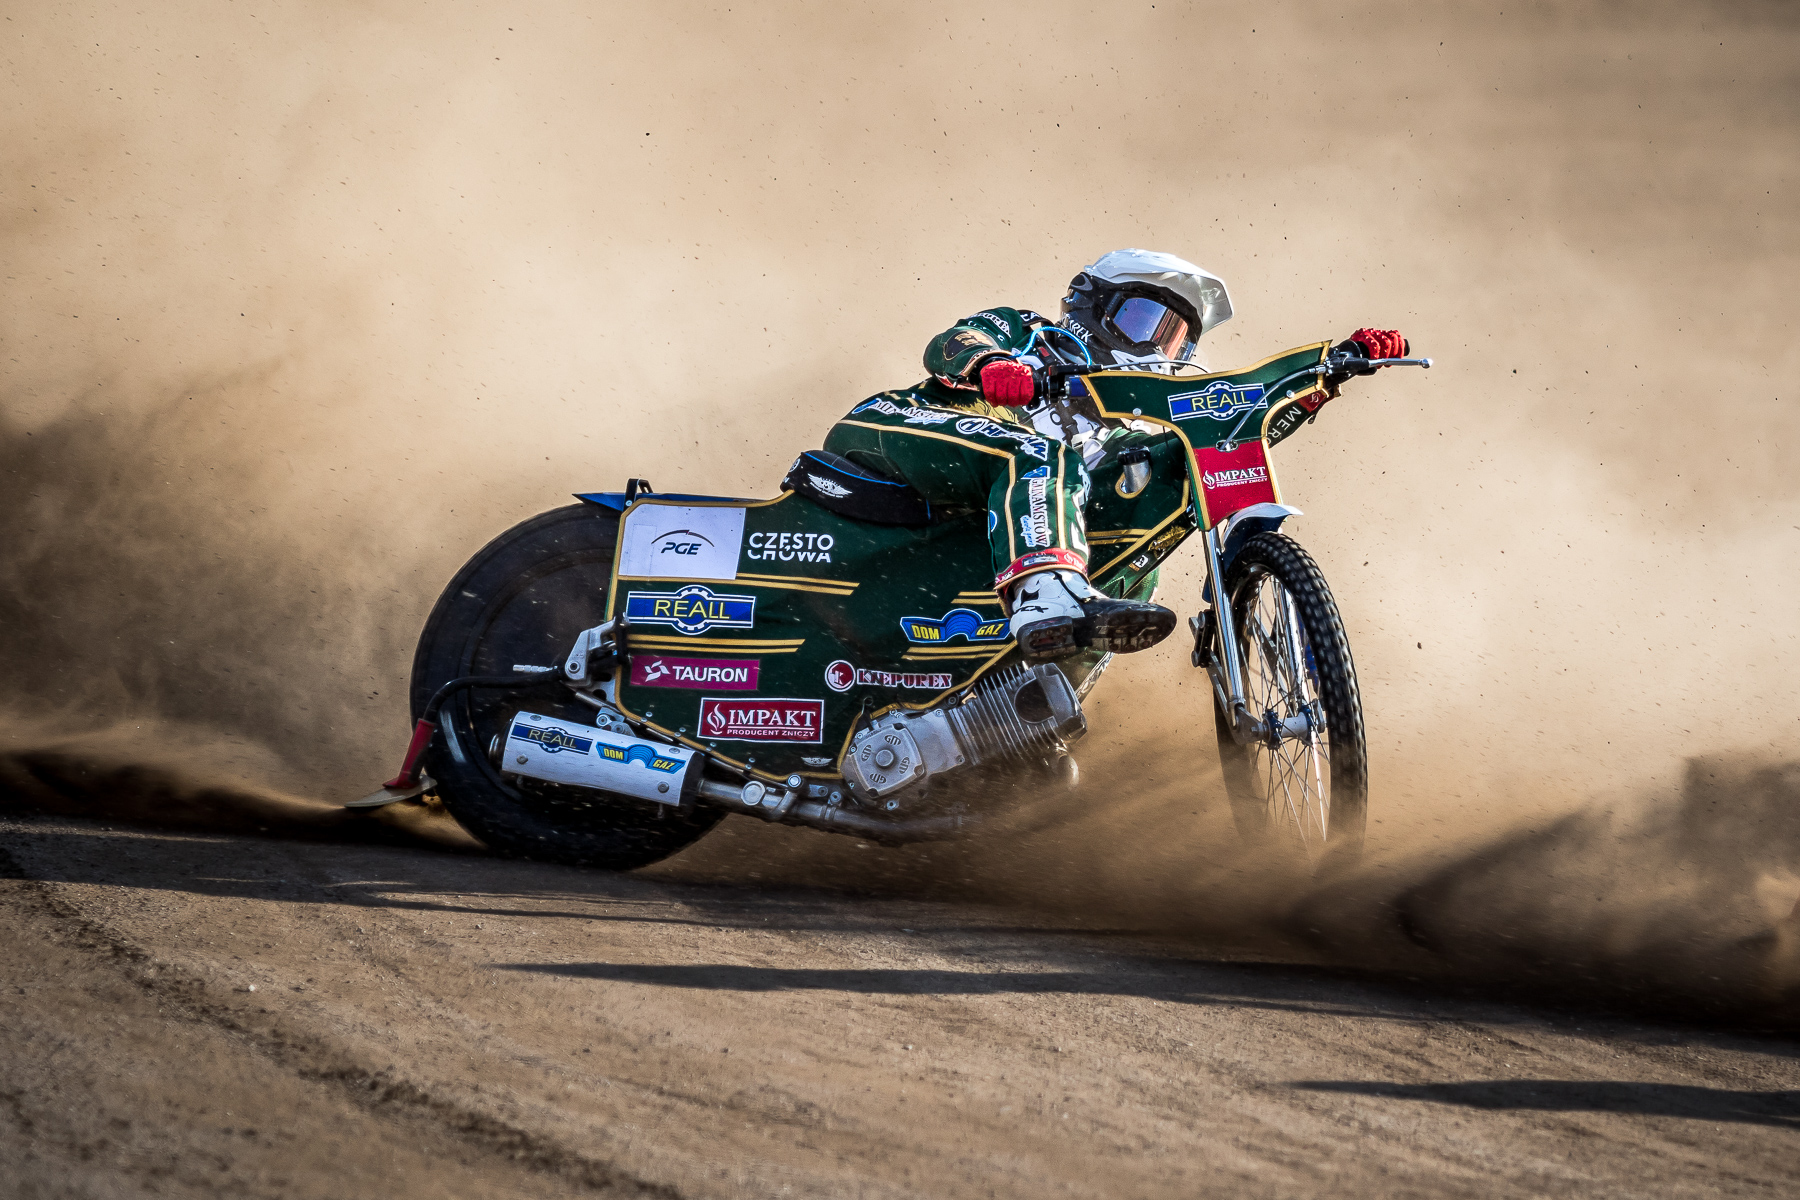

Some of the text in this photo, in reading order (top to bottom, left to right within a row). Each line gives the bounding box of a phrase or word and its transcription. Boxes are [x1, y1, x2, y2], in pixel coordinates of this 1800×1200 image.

[1191, 391, 1251, 411] REALL
[1214, 466, 1266, 481] IMPAKT
[661, 541, 702, 556] PGE
[654, 599, 730, 619] REALL
[911, 622, 1003, 640] DOM GAZ
[672, 665, 748, 683] TAURON
[728, 709, 816, 727] IMPAKT
[528, 729, 578, 749] REALL
[884, 734, 902, 746] GM
[603, 747, 676, 771] DOM GAZ
